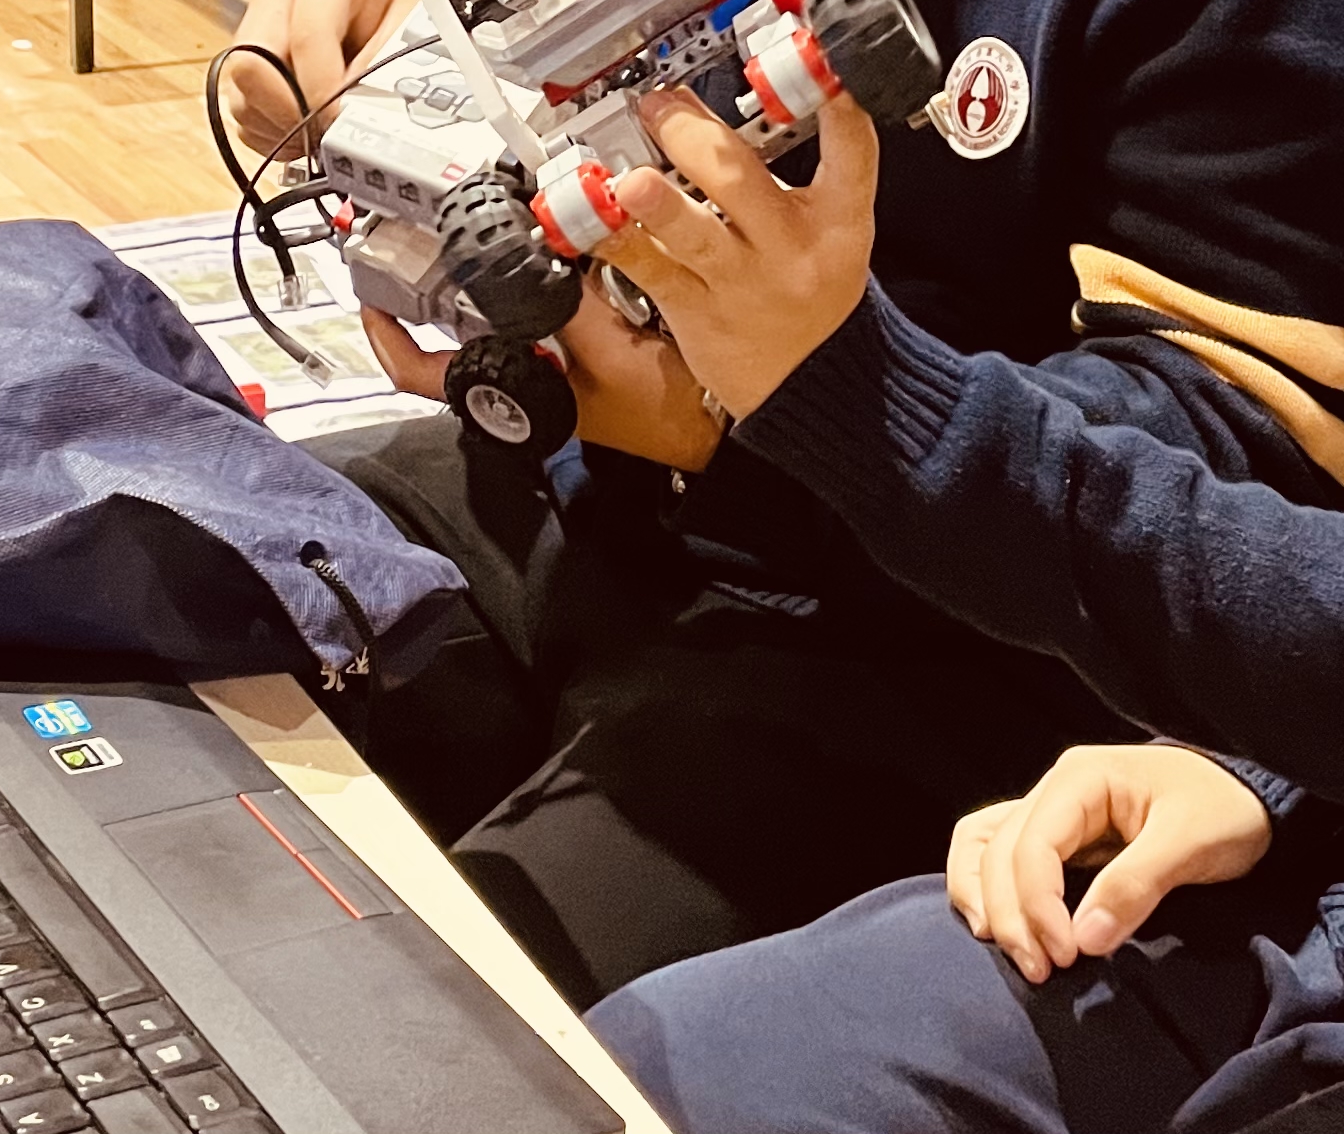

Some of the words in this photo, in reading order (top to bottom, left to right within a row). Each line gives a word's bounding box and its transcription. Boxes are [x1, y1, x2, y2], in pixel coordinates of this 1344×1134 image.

[22, 997, 45, 1009] C
[49, 1033, 74, 1046] X
[78, 1072, 103, 1084] Z
[18, 1112, 43, 1125] A
